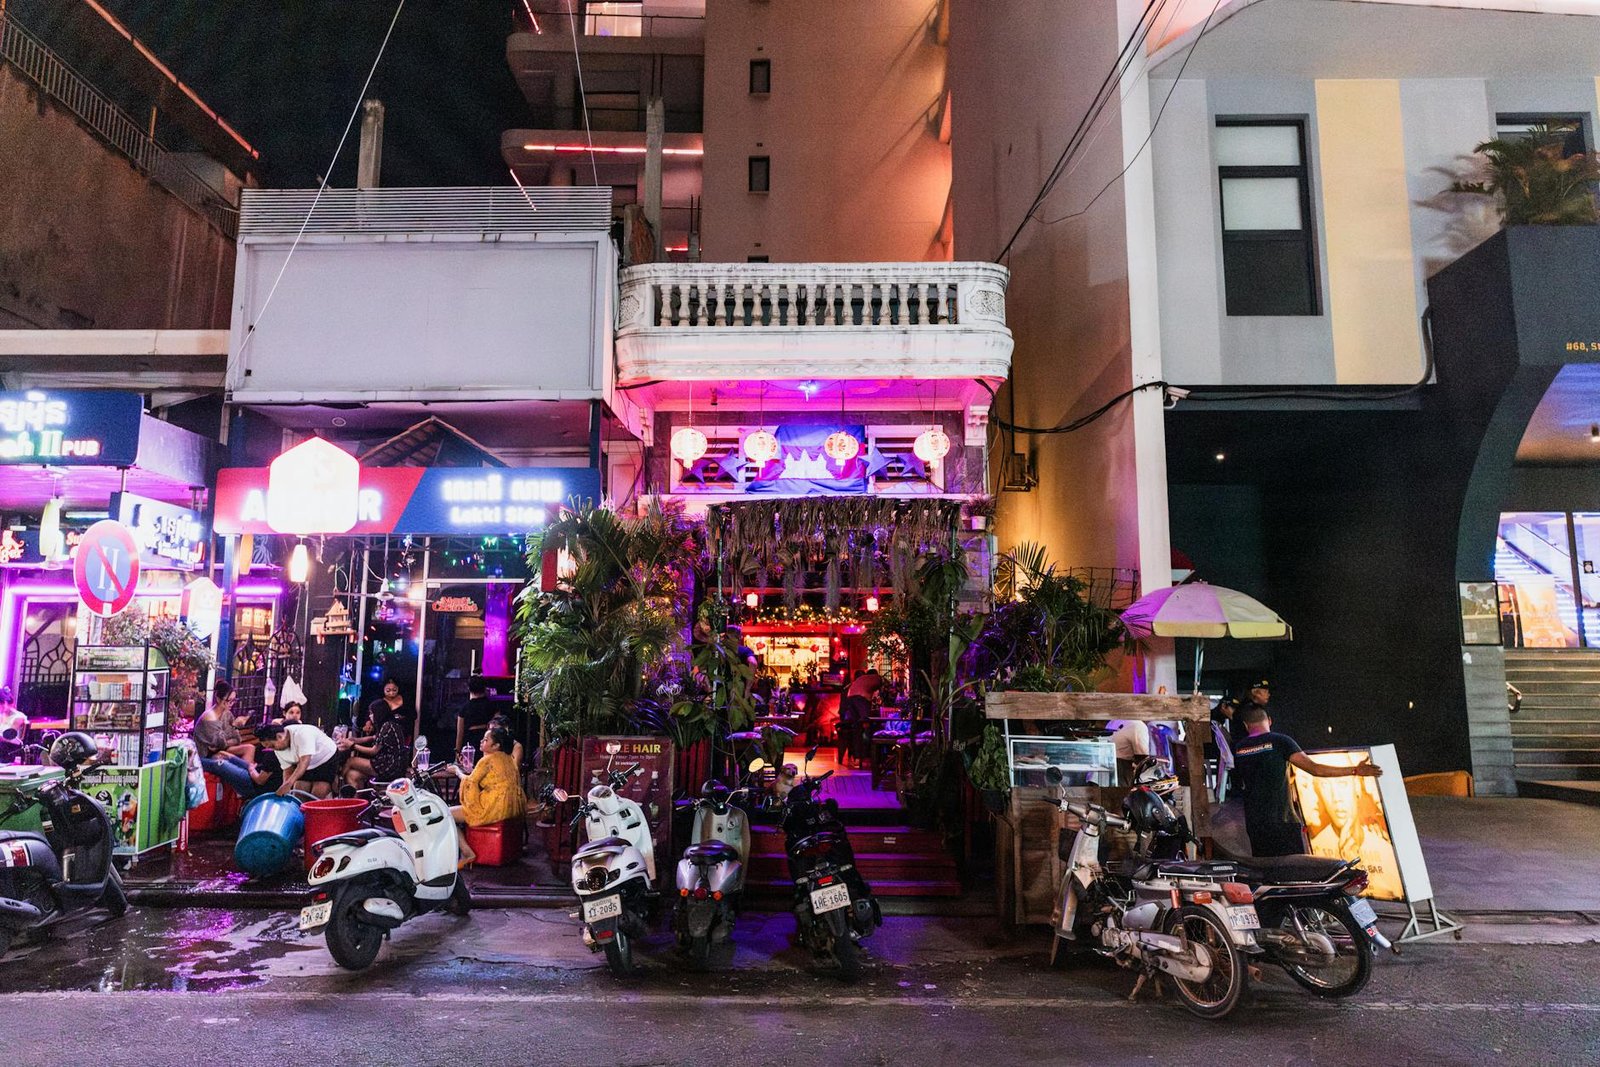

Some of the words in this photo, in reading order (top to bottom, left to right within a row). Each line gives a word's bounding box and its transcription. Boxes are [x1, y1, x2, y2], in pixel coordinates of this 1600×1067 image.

[1566, 342, 1589, 352] #68,
[62, 440, 99, 456] PUB
[632, 743, 661, 753] HAIR
